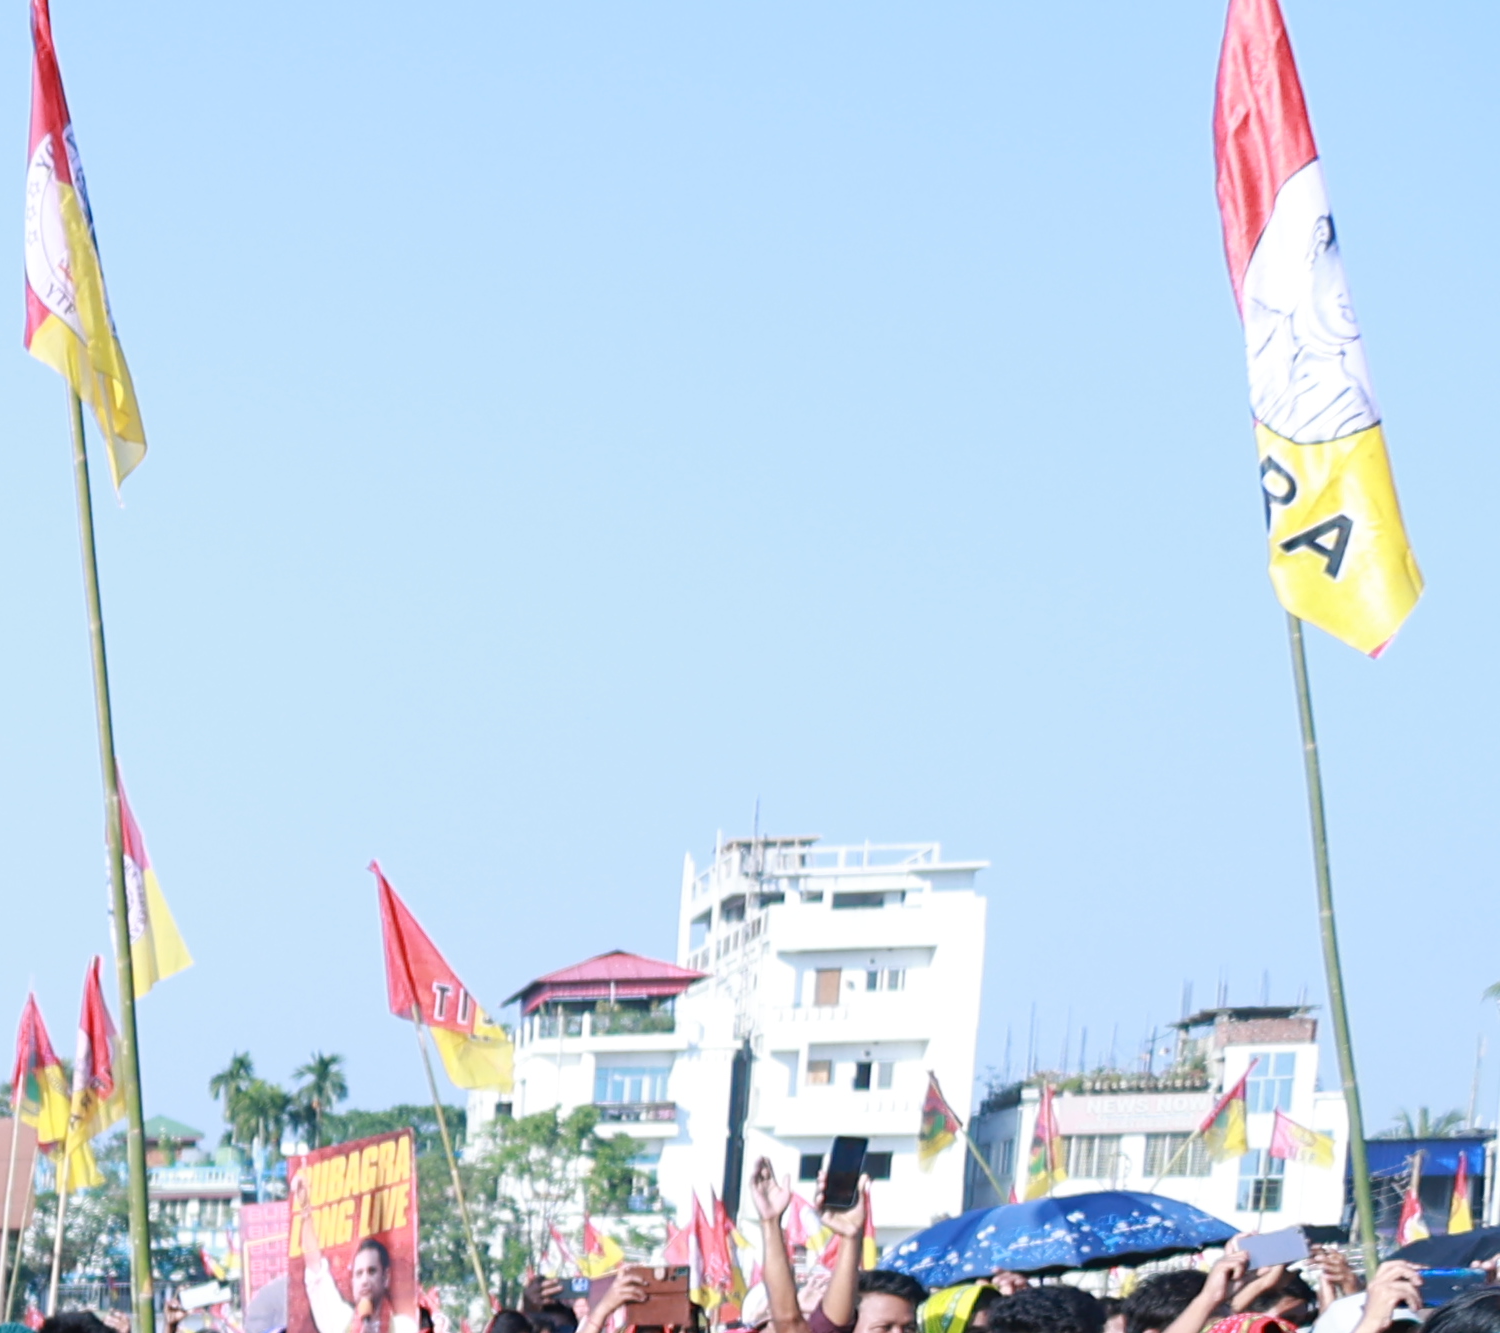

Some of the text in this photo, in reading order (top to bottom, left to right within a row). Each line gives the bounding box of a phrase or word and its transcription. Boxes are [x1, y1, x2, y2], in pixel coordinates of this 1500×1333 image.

[1085, 1095, 1210, 1114] NEWS NOW
[289, 1183, 411, 1258] LNG LIVE
